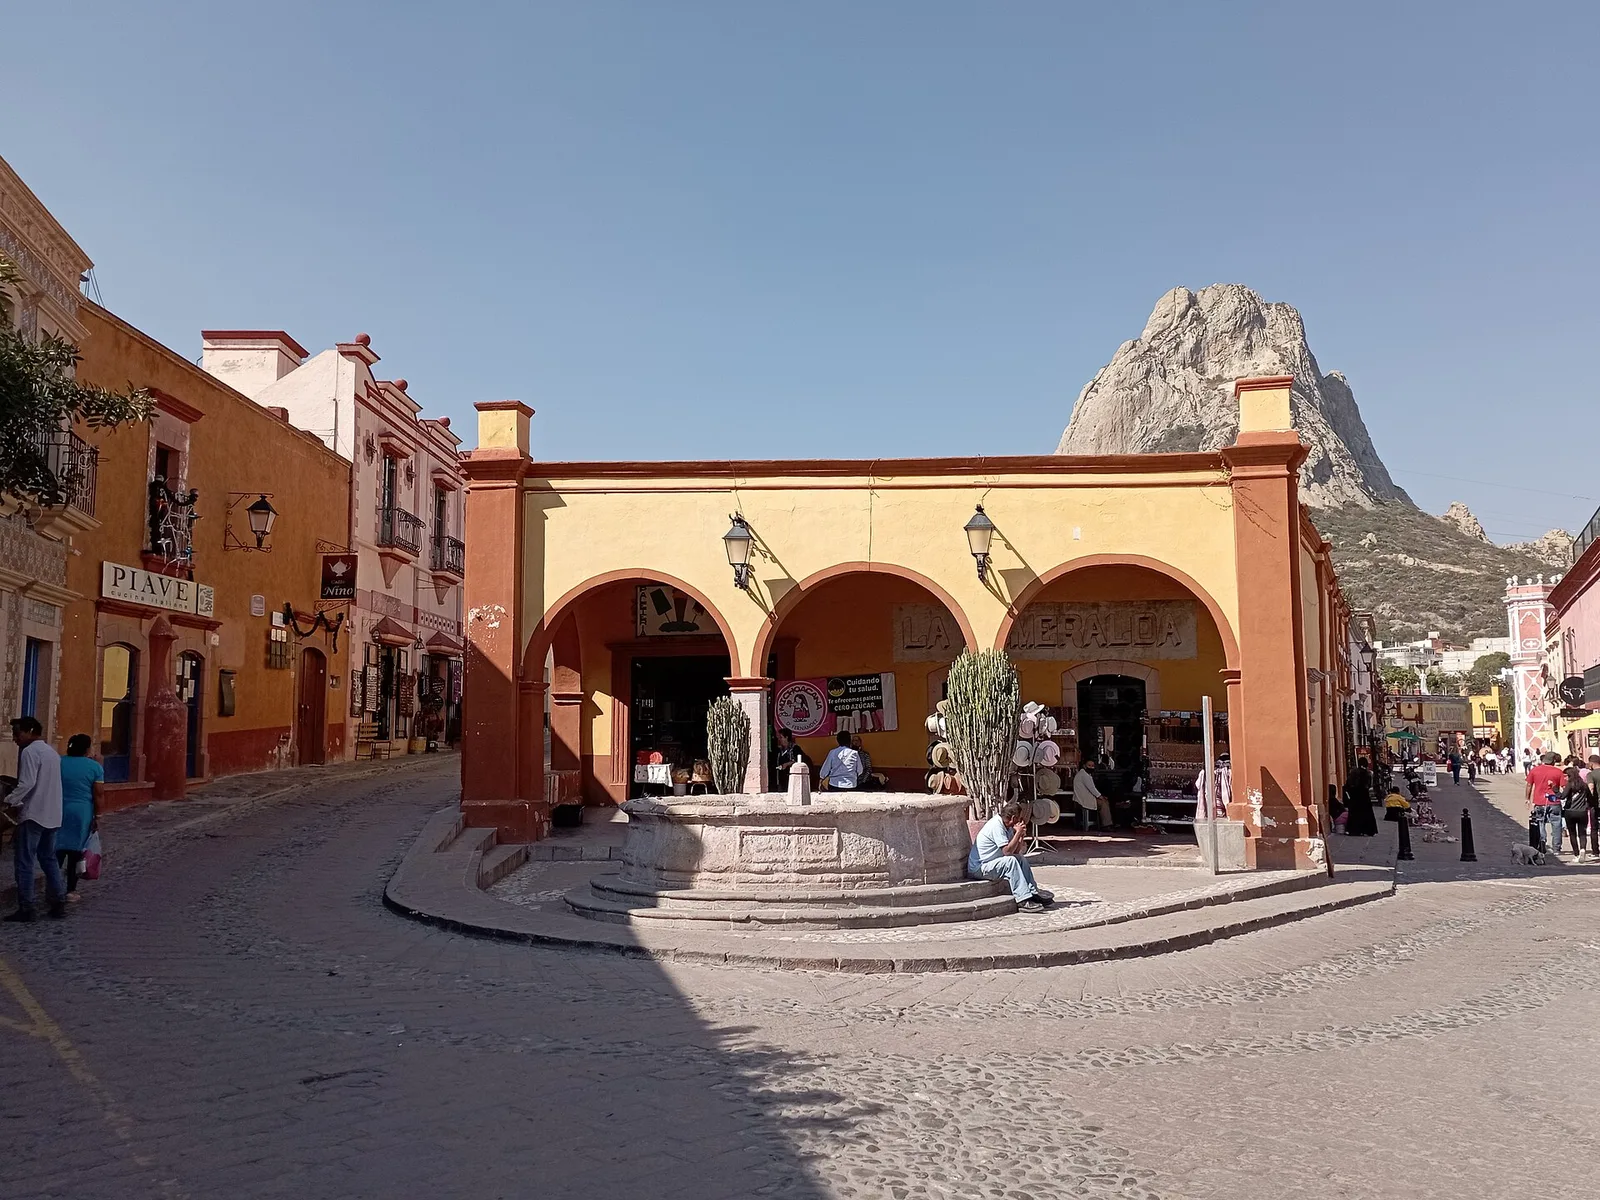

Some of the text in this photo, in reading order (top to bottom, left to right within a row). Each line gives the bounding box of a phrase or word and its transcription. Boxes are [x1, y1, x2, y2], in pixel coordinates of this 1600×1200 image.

[112, 566, 189, 602] PIAVE
[322, 585, 353, 596] Nino
[110, 589, 145, 601] cucina
[151, 598, 188, 610] italiana
[902, 615, 951, 649] LA
[846, 677, 880, 686] Cuidando
[857, 684, 879, 693] salud.
[779, 686, 823, 711] MICHOACANA
[834, 696, 862, 704] ofrecemos
[834, 701, 877, 712] CERO AZÚCAR.
